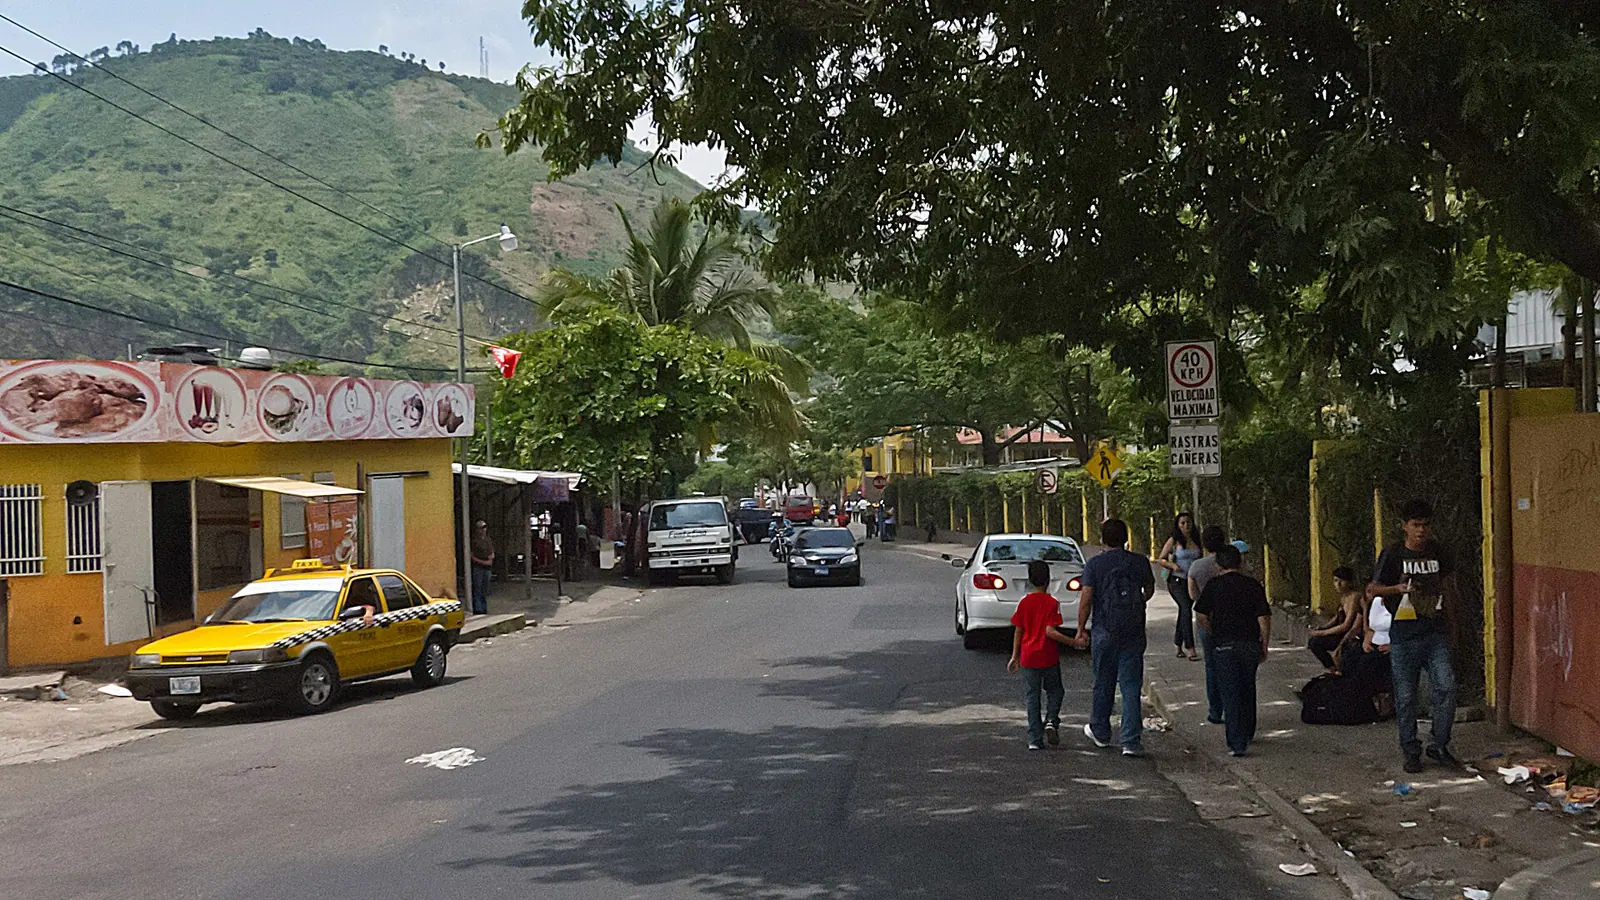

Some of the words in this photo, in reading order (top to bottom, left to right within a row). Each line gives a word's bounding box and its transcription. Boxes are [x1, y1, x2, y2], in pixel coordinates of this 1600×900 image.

[1180, 351, 1200, 367] 40
[1180, 367, 1203, 379] KPH
[1170, 388, 1215, 402] VELOCIDAD
[1173, 403, 1213, 416] MAXIMA
[1171, 435, 1218, 448] RASTRAS
[1171, 449, 1219, 465] CAÑERAS
